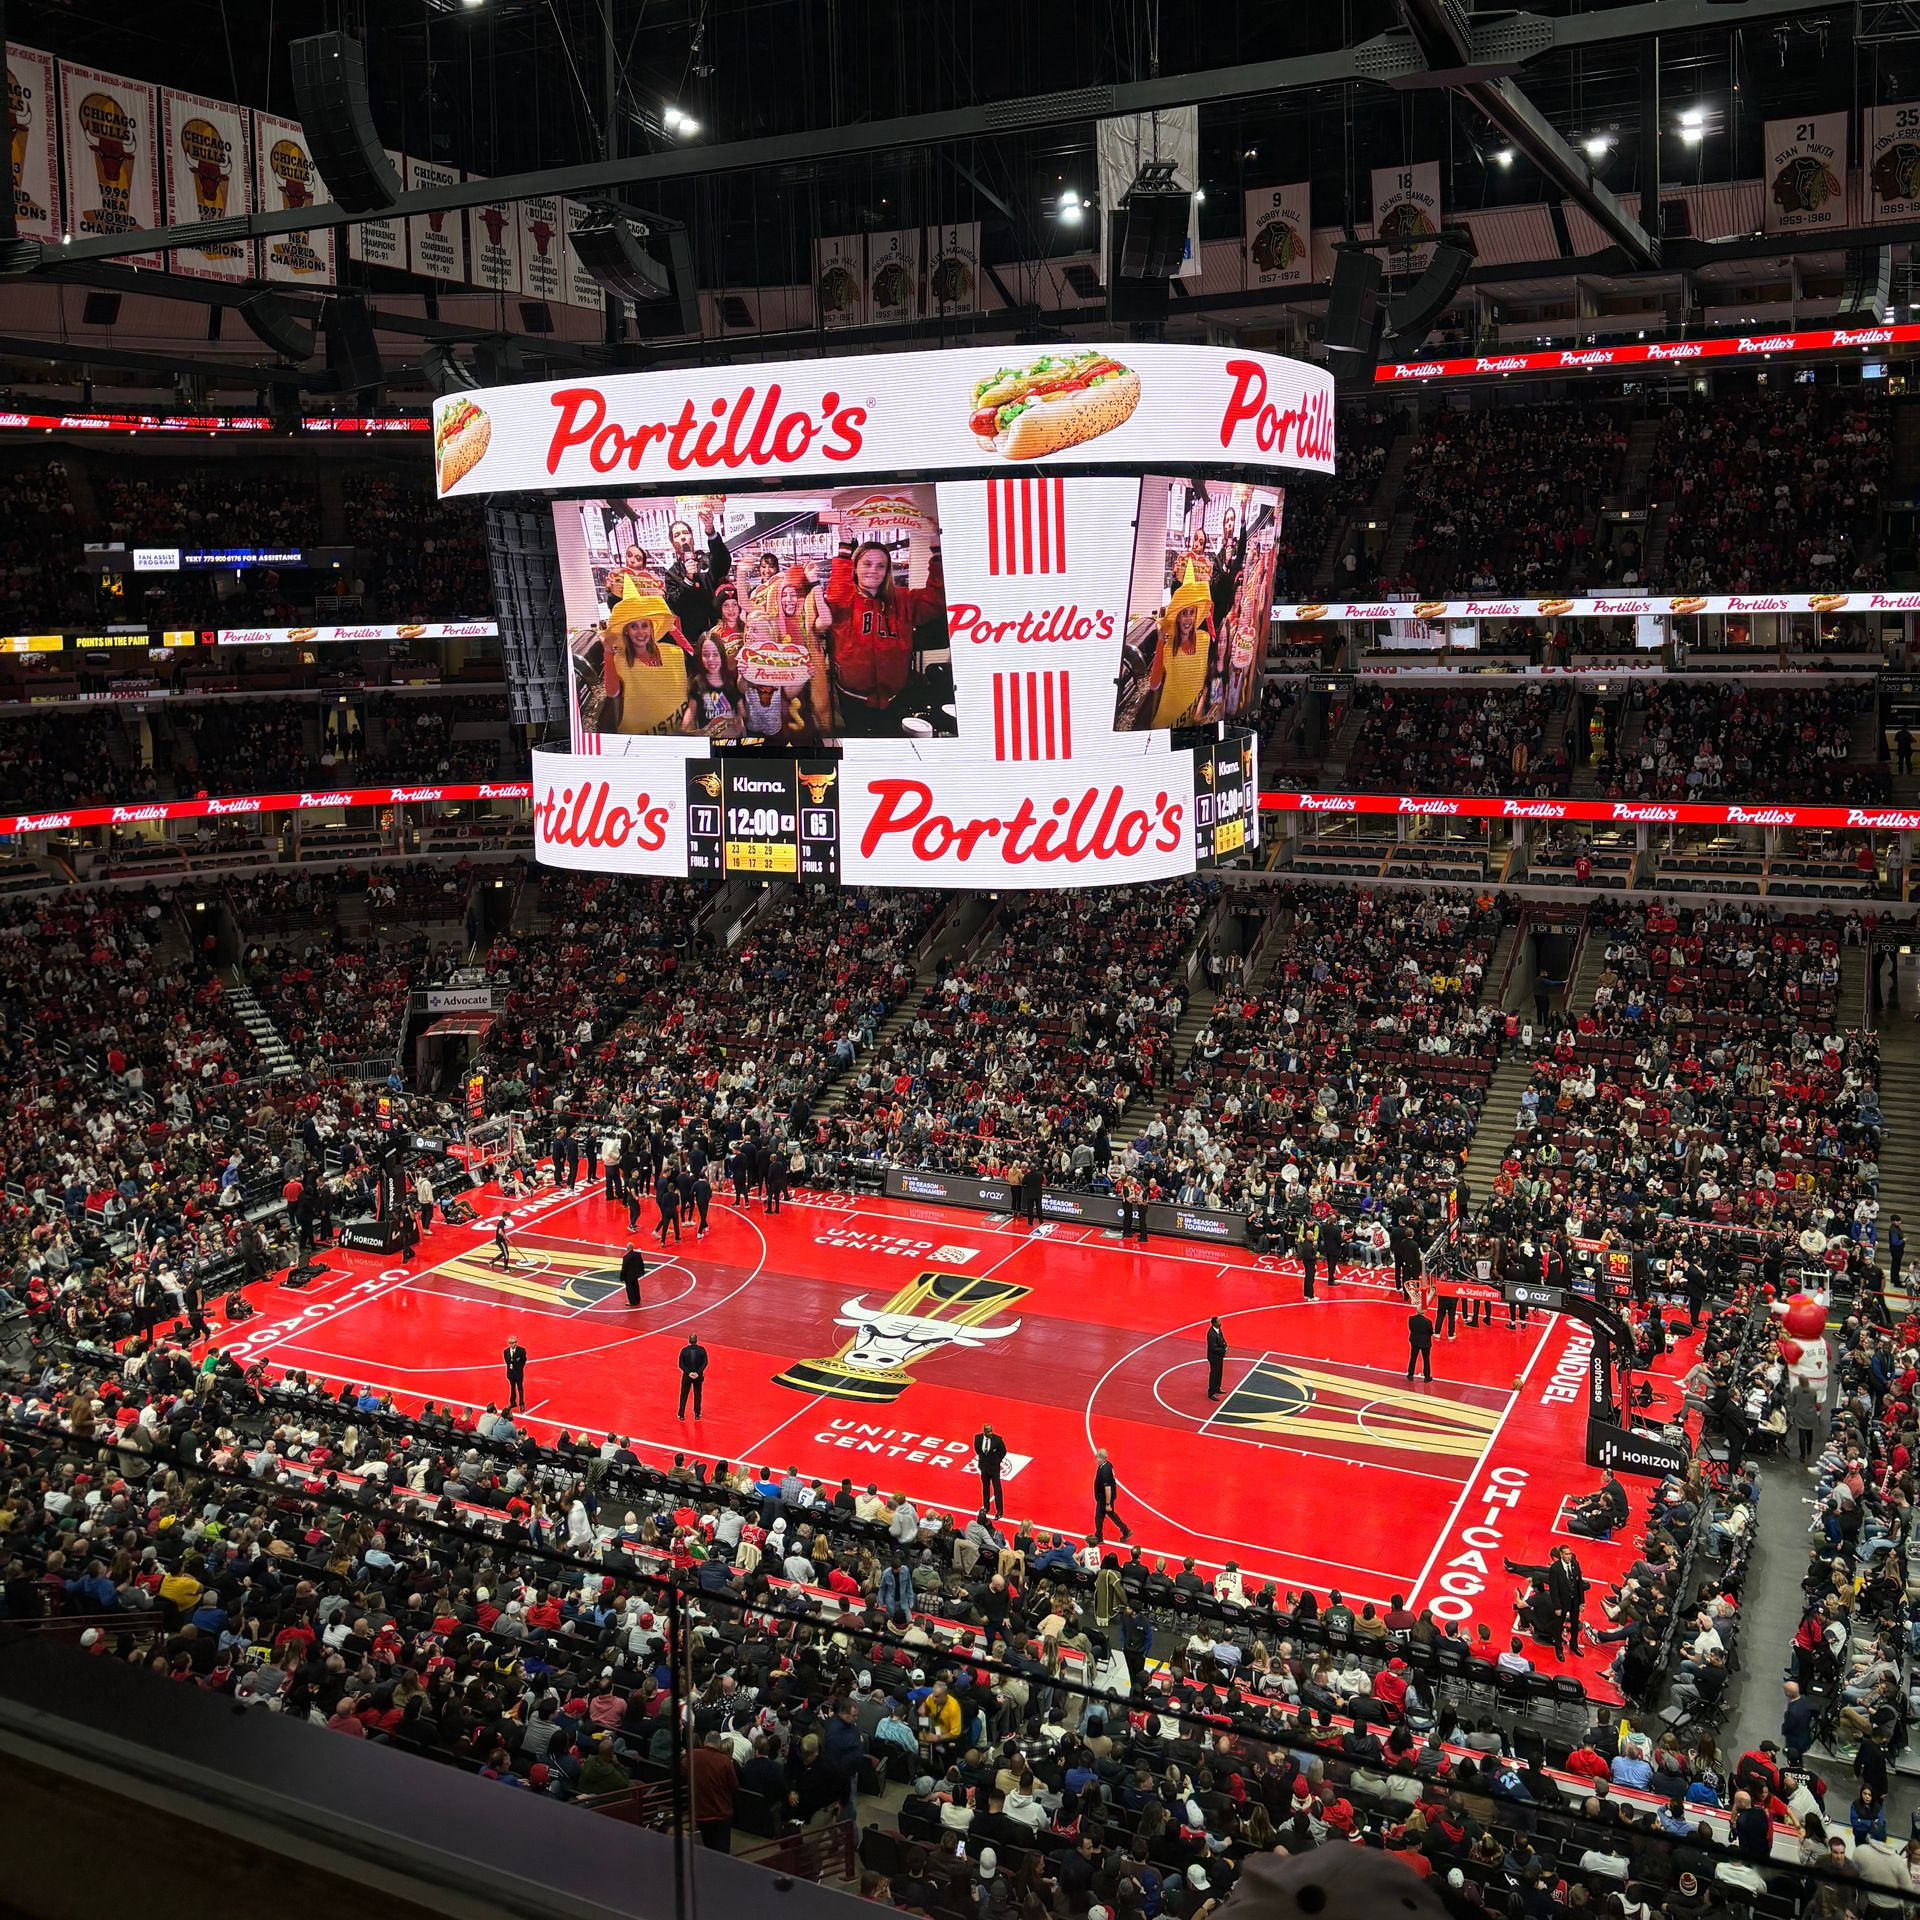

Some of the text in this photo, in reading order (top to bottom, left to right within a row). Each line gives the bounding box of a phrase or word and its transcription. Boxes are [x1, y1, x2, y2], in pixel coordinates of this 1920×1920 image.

[83, 106, 136, 129] CHICAGO
[1896, 109, 1919, 128] 35
[91, 120, 130, 141] BULLS
[1796, 123, 1815, 141] 21
[184, 129, 232, 152] CHICAGO
[1874, 133, 1897, 151] TONY
[191, 146, 226, 164] BULLS
[273, 150, 316, 172] CHICAGO
[1774, 144, 1835, 165] STAN MIKITA
[281, 166, 310, 182] BULLS
[414, 165, 453, 185] CHICAGO
[1398, 173, 1413, 189] 18
[99, 184, 128, 199] 1996
[102, 198, 127, 211] NBA
[1272, 192, 1282, 207] 9
[1379, 191, 1435, 213] DENIS SAVARD
[93, 210, 137, 226] WORLD
[198, 204, 223, 218] 1997
[529, 208, 553, 222] BULLS
[1256, 209, 1300, 228] BOBBY HULL
[288, 233, 308, 246] NBA
[425, 232, 448, 243] EASTERN
[890, 237, 898, 251] 3
[949, 231, 957, 245] 3
[280, 243, 315, 259] WORLD
[420, 240, 454, 255] CONFERENCE
[834, 242, 839, 256] 1
[270, 253, 326, 272] CHAMPIONS
[421, 251, 455, 265] CHAMPIONS
[1258, 271, 1300, 283] 1957-1972
[1737, 338, 1796, 352] Portillo's
[1832, 330, 1894, 345] Portillo's
[1560, 350, 1614, 365] Portillo's
[1647, 344, 1703, 359] Portillo's
[1394, 364, 1444, 378] Portillo's
[1476, 357, 1528, 371] Portillo's
[1220, 359, 1333, 461] Portill
[547, 383, 867, 475] Portillo's
[258, 553, 302, 562] ASSISTANCE
[1345, 605, 1396, 617] Portillo's
[1465, 602, 1520, 615] Portillo's
[1593, 600, 1651, 613] Portillo's
[1728, 597, 1787, 610] Portillo's
[442, 624, 488, 636] Portillo's
[947, 604, 1115, 644] Portillo's
[223, 631, 272, 642] Portillo's
[334, 628, 381, 639] Portillo's
[76, 635, 149, 648] POINTS IN THE PAINT
[478, 784, 529, 798] Portillo's
[733, 776, 786, 793] Klarna.
[299, 793, 353, 807] Portillo's
[390, 788, 443, 801] Portillo's
[207, 799, 261, 813] Portillo's
[1300, 795, 1356, 811] Portillo's
[1399, 797, 1459, 813] Portillo's
[1503, 800, 1566, 817] Portillo's
[112, 807, 168, 822] Portillo's
[1612, 803, 1679, 820] Portillo's
[1727, 807, 1796, 823] Portillo's
[15, 815, 72, 831] Portillo's
[697, 809, 712, 832] 77
[727, 808, 791, 836] 12:00 4
[810, 813, 827, 836] 65
[860, 778, 1183, 864] Portillo's
[690, 841, 719, 853] TO 4
[731, 844, 740, 854] 23
[748, 845, 756, 855] 25
[802, 845, 834, 858] TO 4
[690, 856, 709, 868] FOULS
[749, 858, 756, 868] 17
[764, 859, 773, 869] 32
[802, 861, 823, 873] FOULS
[443, 996, 488, 1006] Advocate
[469, 1085, 482, 1102] 24
[909, 1186, 948, 1196] TOURNAMENT
[986, 1191, 1004, 1200] razr
[1184, 1217, 1219, 1227] IN-SEASON
[1184, 1224, 1229, 1235] TOURNAMENT
[353, 1234, 384, 1247] HORIZON
[826, 1228, 933, 1249] UNITED
[814, 1236, 921, 1258] CENTER
[1610, 1262, 1625, 1274] 24
[1530, 1292, 1551, 1301] razr
[219, 1269, 410, 1356] CHICAGO
[1540, 1335, 1595, 1405] FANDUEL
[1594, 1357, 1602, 1403] coinbase
[829, 1418, 970, 1454] UNITED
[813, 1432, 954, 1469] CENTER
[1622, 1451, 1680, 1471] HORIZON
[1428, 1467, 1530, 1620] CHICAGO
[1089, 1556, 1100, 1566] 21
[1500, 1771, 1521, 1790] 23
